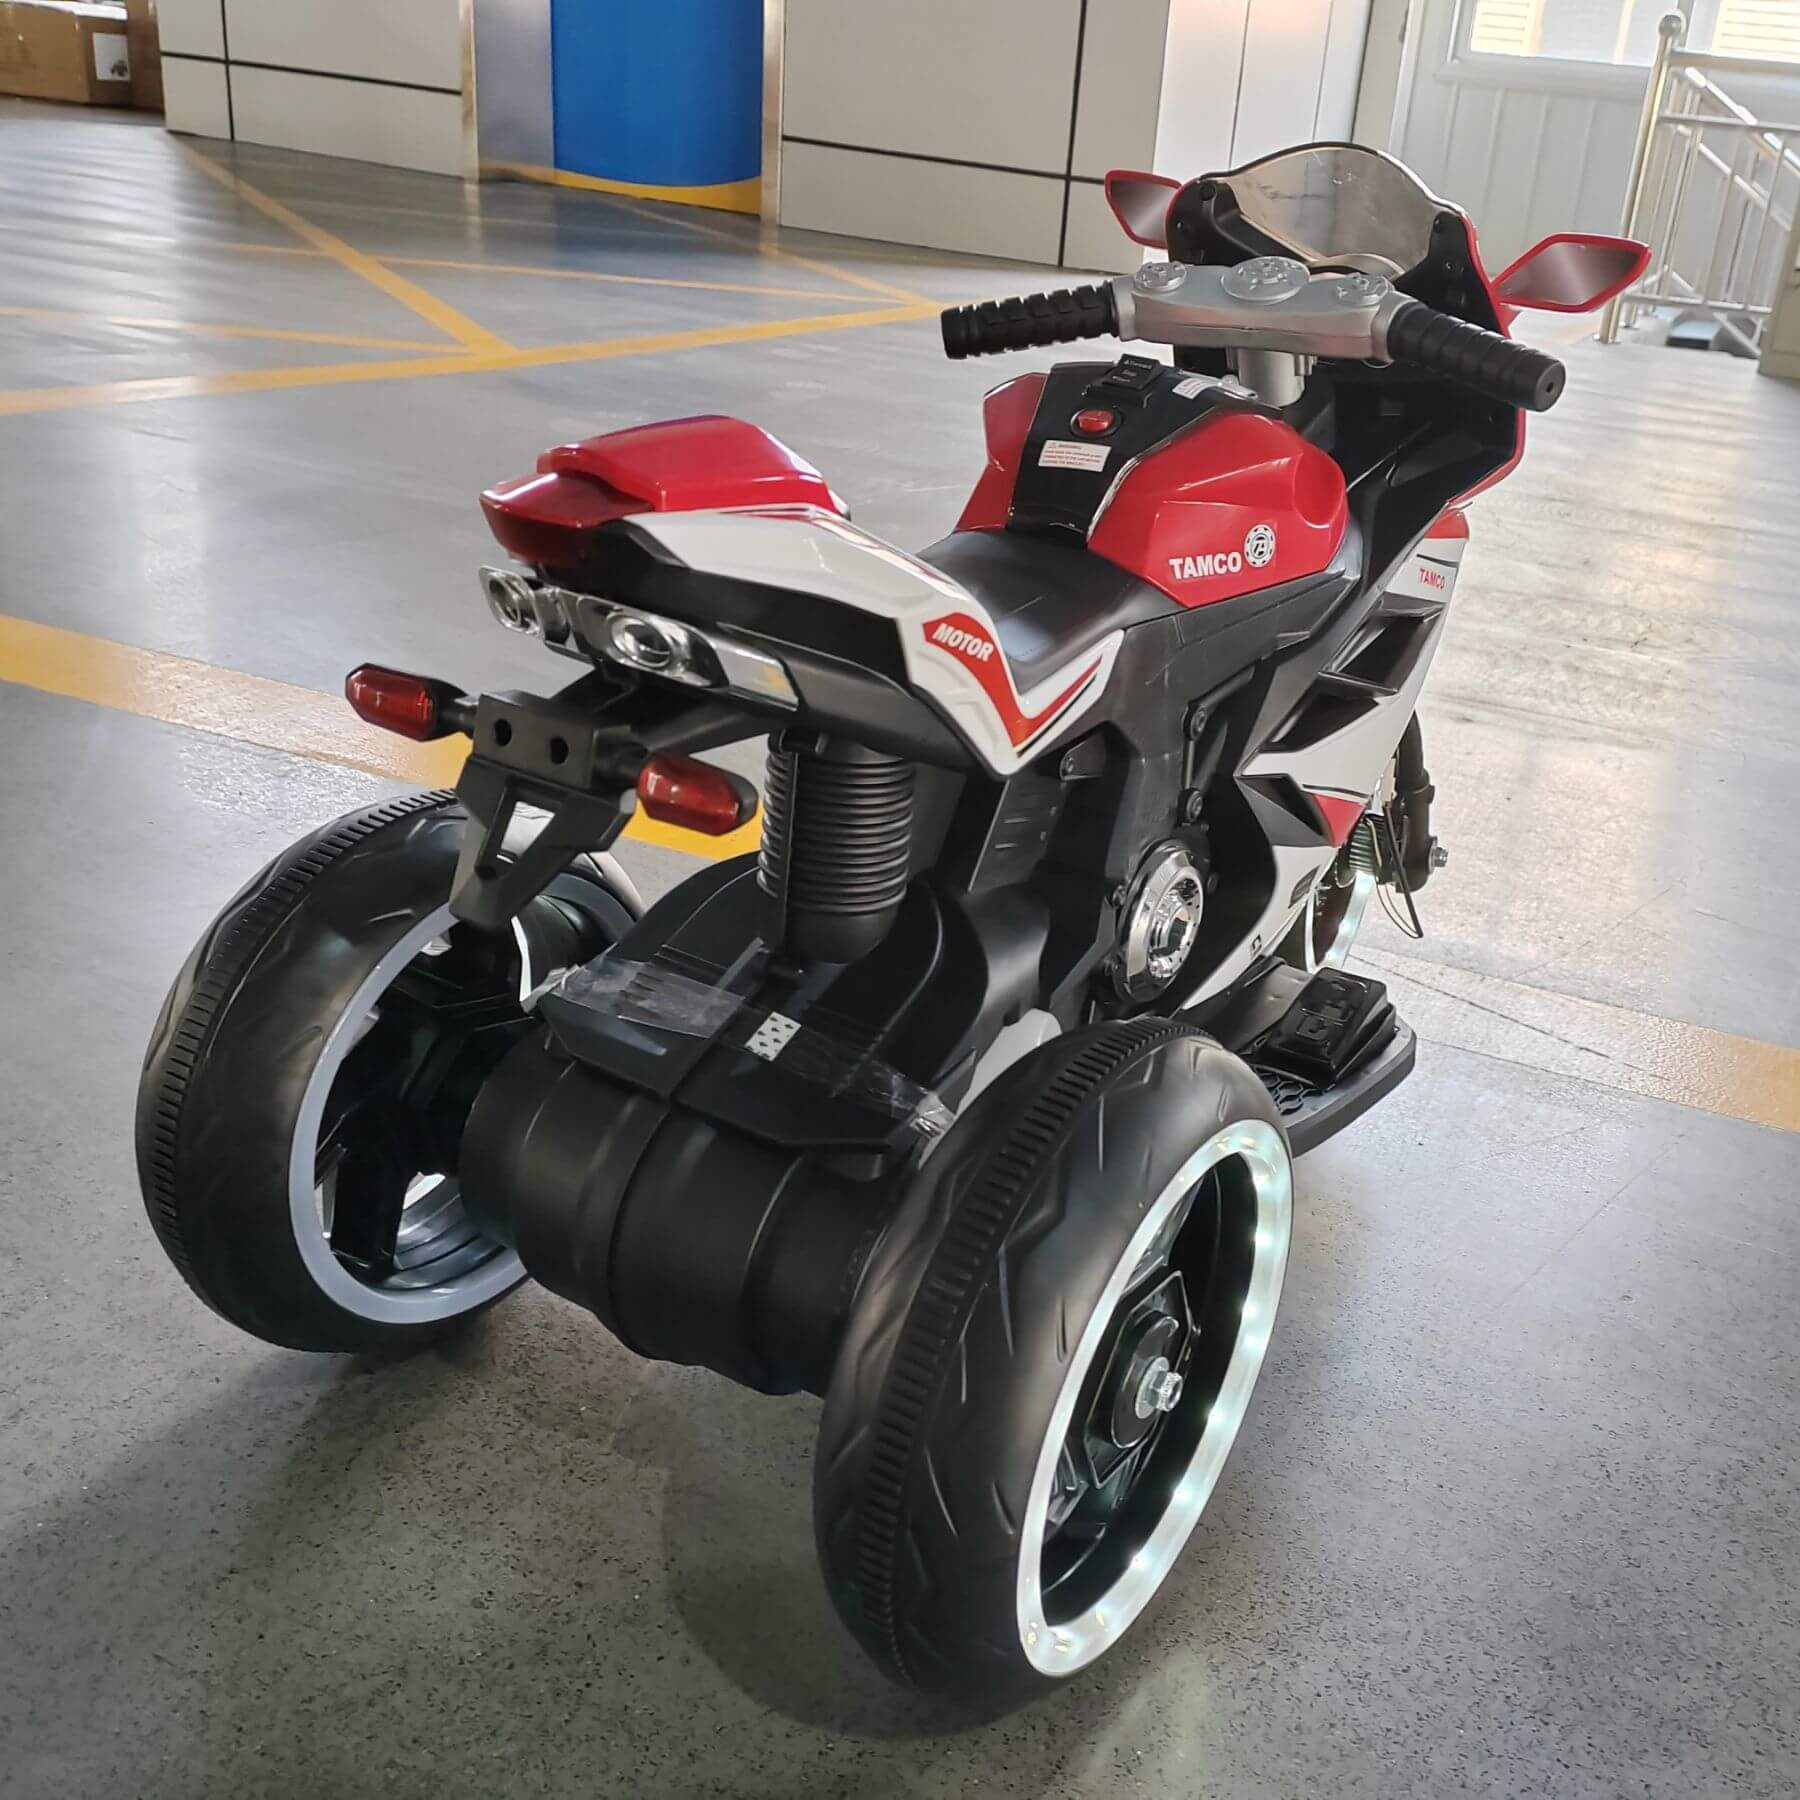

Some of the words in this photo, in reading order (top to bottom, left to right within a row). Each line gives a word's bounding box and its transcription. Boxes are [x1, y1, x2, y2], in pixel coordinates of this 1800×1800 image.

[1168, 551, 1242, 580] TAMCO
[1419, 567, 1446, 590] TAMCO
[931, 622, 994, 662] MOTOR
